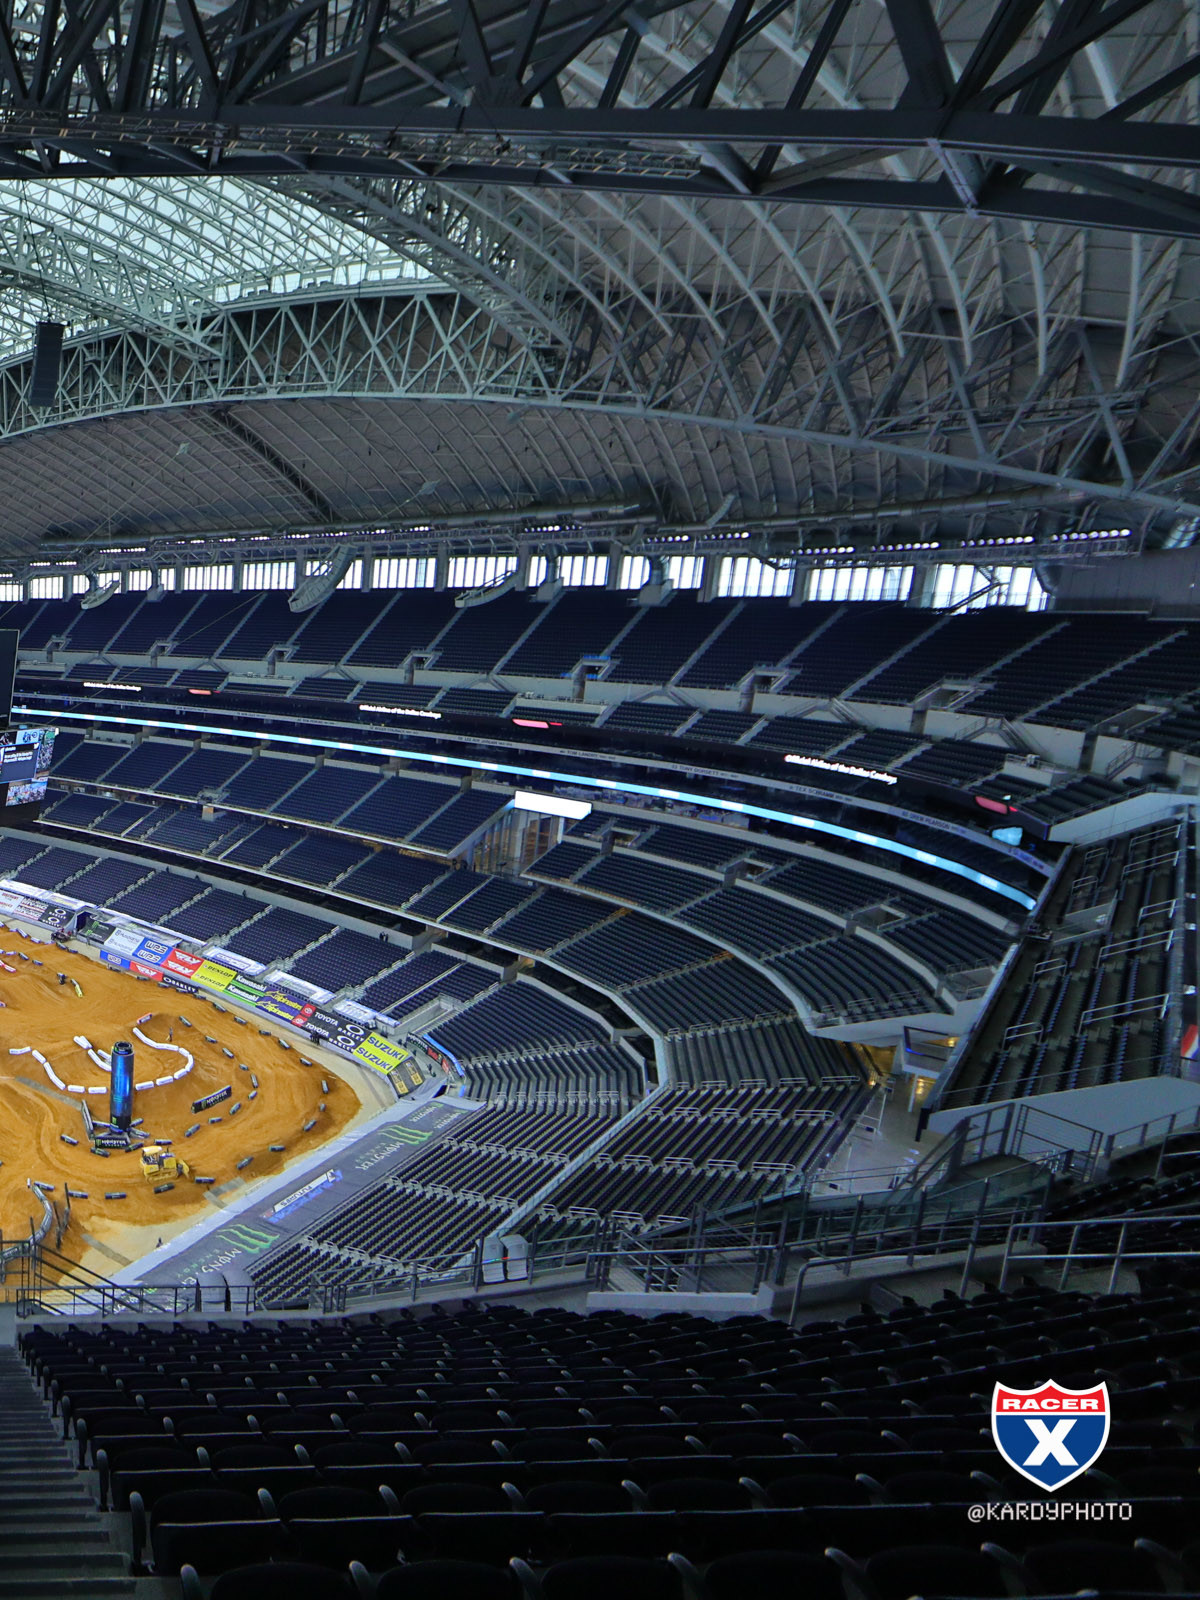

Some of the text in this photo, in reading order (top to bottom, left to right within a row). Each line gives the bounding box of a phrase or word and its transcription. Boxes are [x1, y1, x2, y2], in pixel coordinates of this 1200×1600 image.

[784, 754, 811, 766] Official
[811, 758, 831, 770] Airline
[849, 766, 870, 778] Dallas
[870, 770, 898, 786] Cowboys
[146, 941, 168, 954] WPS
[208, 966, 233, 978] DUNLOP
[171, 980, 196, 993] OAKLEY
[200, 975, 225, 987] DUNLOP
[235, 974, 268, 992] Kawasaki
[227, 984, 260, 1002] Kawasaki
[314, 1012, 339, 1026] TOYOTA
[305, 1023, 330, 1037] TOYOTA
[338, 1028, 365, 1042] OAKLEY
[329, 1038, 355, 1054] OAKLEY
[367, 1036, 405, 1060] SUZUKI
[356, 1047, 393, 1071] SUZUKI
[280, 1185, 313, 1207] FUTURES
[181, 1247, 242, 1289] MONSER
